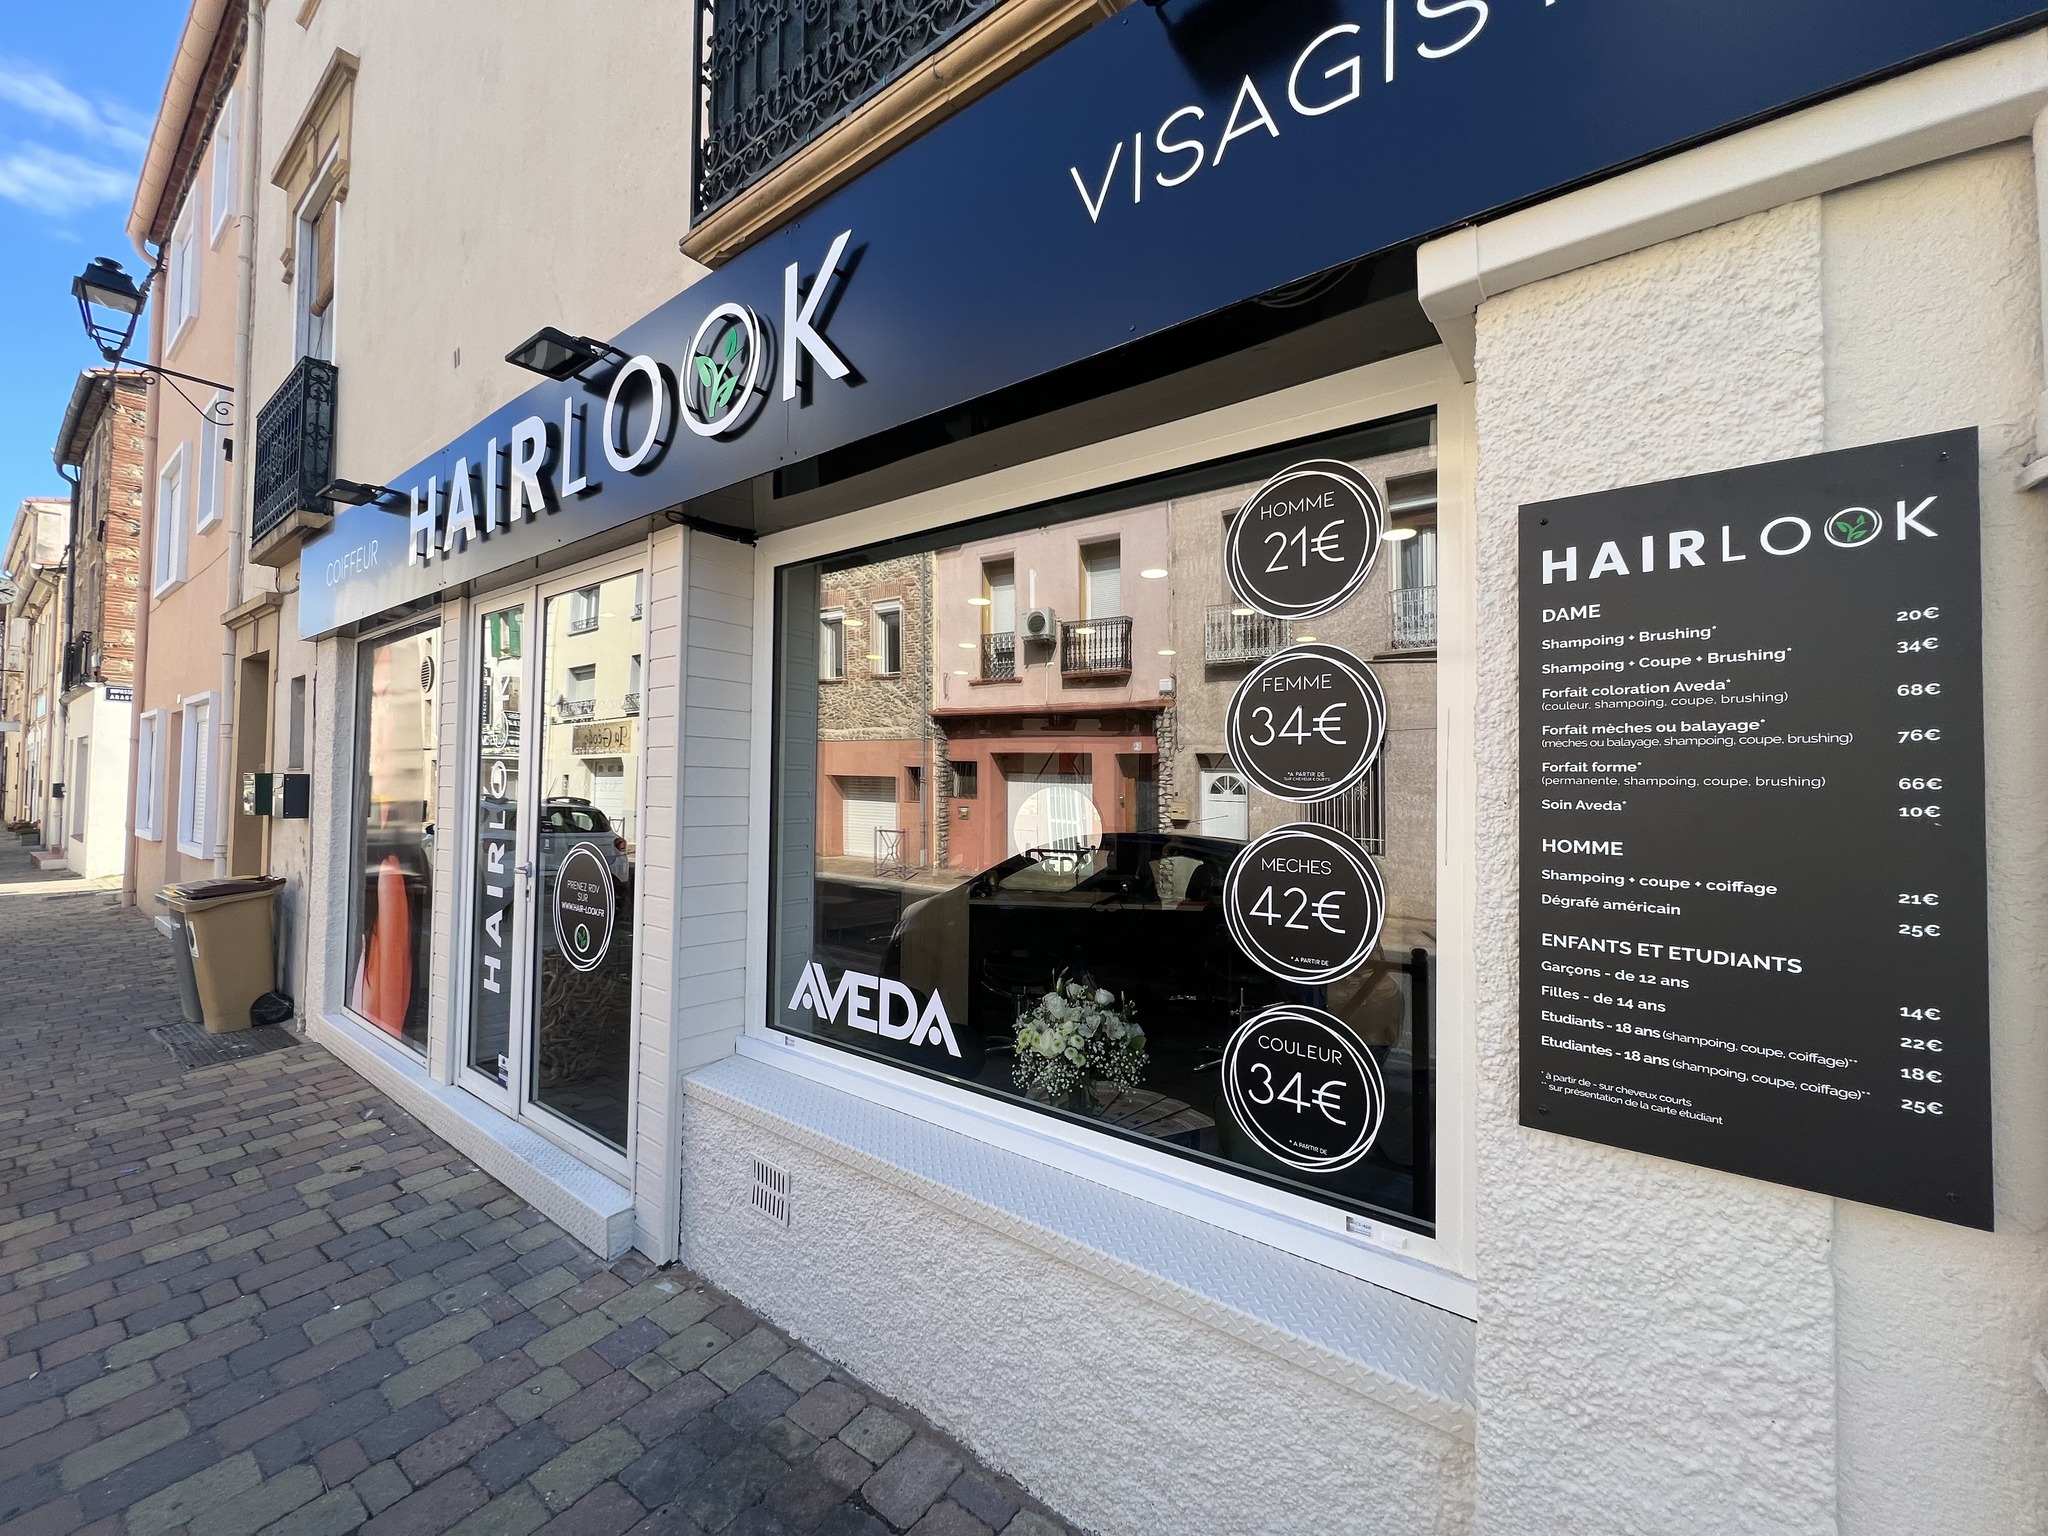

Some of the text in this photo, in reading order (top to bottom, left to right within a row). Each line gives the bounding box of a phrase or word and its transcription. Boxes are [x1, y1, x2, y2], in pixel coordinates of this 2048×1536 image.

[1070, 0, 1556, 224] VISAGIS
[408, 229, 851, 567] HAIRLOOK
[1260, 492, 1335, 520] HOMME
[1264, 519, 1345, 573] 21€
[1542, 497, 1938, 584] HAIRLOOK
[326, 540, 378, 586] COIFFEUR
[1543, 604, 1601, 622] DAME
[1897, 607, 1939, 621] 20€
[1542, 635, 1624, 649] Shampoing
[1897, 637, 1938, 653] 34€
[1542, 660, 1624, 674] Shampoing
[1639, 657, 1691, 669] Coupe
[1262, 674, 1332, 692] FEMME
[1543, 687, 1588, 698] Forfait
[1592, 683, 1669, 696] coloration
[1897, 683, 1941, 696] 68€
[1721, 692, 1788, 704] brushing)
[1249, 703, 1347, 746] 34€
[1543, 724, 1588, 735] Forfait
[1592, 723, 1652, 734] mèches
[1656, 724, 1676, 732] ou
[1542, 739, 1588, 747] (mèches
[1788, 733, 1853, 745] brushing)
[1898, 729, 1940, 743] 76€
[1542, 762, 1588, 772] Forfait
[1756, 776, 1825, 789] brushing)
[1899, 778, 1942, 790] 66€
[1542, 799, 1572, 809] Soin
[1899, 806, 1940, 817] 10€
[1543, 839, 1623, 856] HOMME
[1261, 858, 1332, 876] MECHES
[567, 880, 600, 894] PRENEZ RDV
[1542, 870, 1624, 887] Shampoing
[1639, 878, 1690, 890] coupe
[1706, 880, 1777, 896] coiffage
[578, 892, 588, 902] SUR
[1542, 894, 1680, 915] Dégrafé américain
[1898, 894, 1938, 905] 21€
[1249, 885, 1346, 934] 42€
[1899, 924, 1940, 937] 25€
[1300, 957, 1320, 965] PARTIR
[1542, 933, 1802, 973] ENFANTS ET ETUDIANTS
[1541, 961, 1600, 977] Garçons
[1615, 970, 1635, 981] de
[1639, 974, 1656, 984] 12
[1661, 978, 1689, 988] ans
[1542, 986, 1579, 1000] Filles
[1593, 993, 1613, 1004] de
[1617, 998, 1634, 1009] 14
[1638, 1001, 1666, 1012] ans
[788, 960, 962, 1058] AVEDA
[1900, 1007, 1940, 1020] 14€
[1542, 1010, 1604, 1029] Etudiants
[1616, 1023, 1631, 1033] 18
[1634, 1027, 1660, 1038] ans
[1258, 1035, 1343, 1065] COULEUR
[1542, 1035, 1612, 1056] Etudiantes
[1624, 1051, 1640, 1061] 18
[1643, 1055, 1670, 1066] ans
[1901, 1038, 1942, 1052] 22€
[1901, 1068, 1942, 1083] 18€
[1248, 1062, 1346, 1125] 34€
[1553, 1075, 1577, 1083] partir
[1578, 1078, 1591, 1087] de
[1616, 1086, 1657, 1100] cheveux
[1659, 1095, 1692, 1106] courts
[1565, 1087, 1623, 1104] présentation
[1625, 1099, 1638, 1107] de
[1640, 1101, 1649, 1109] la
[1651, 1105, 1677, 1115] carte
[1679, 1109, 1723, 1124] étudiant
[1901, 1099, 1943, 1114] 25€
[1299, 1142, 1318, 1152] PARTIR
